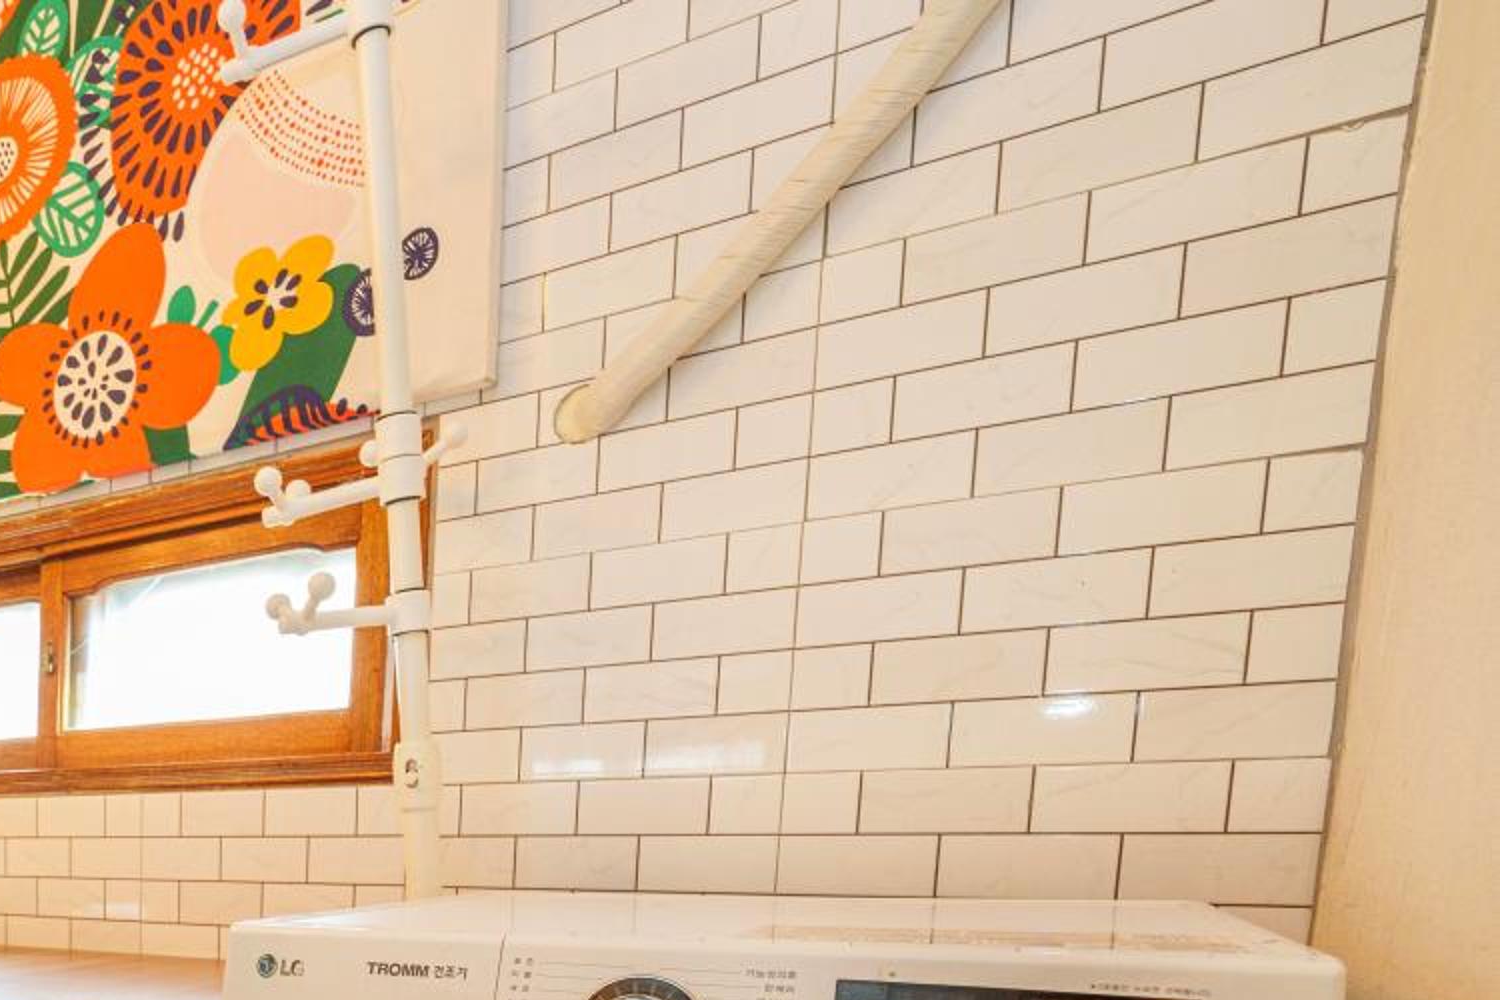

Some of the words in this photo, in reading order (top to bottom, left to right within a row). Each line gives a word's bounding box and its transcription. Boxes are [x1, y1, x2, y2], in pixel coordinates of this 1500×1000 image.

[280, 960, 305, 976] LG
[367, 961, 429, 977] TROMM
[434, 964, 468, 981] 건조기
